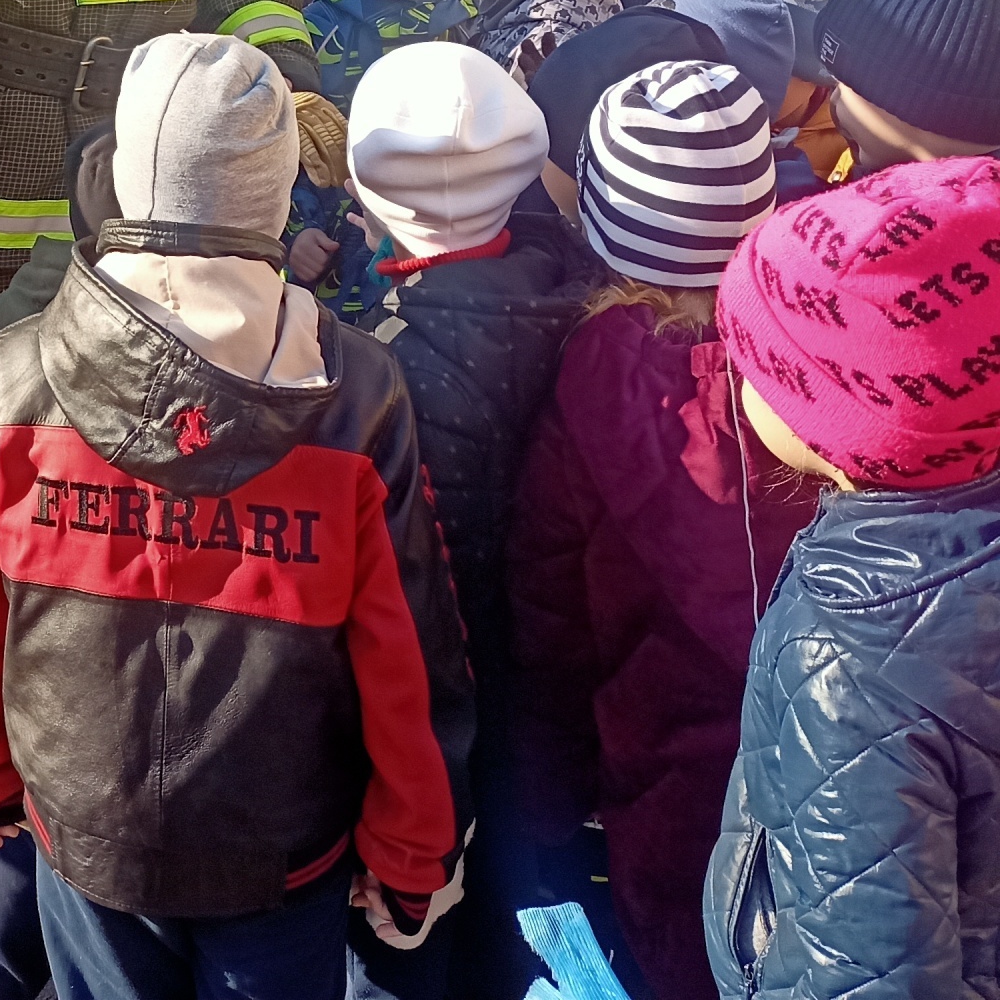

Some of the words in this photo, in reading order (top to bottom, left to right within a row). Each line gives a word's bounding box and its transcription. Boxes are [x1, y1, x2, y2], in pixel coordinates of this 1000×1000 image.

[862, 206, 938, 263] LAY
[881, 262, 991, 331] LETS
[31, 476, 321, 564] FERRARI
